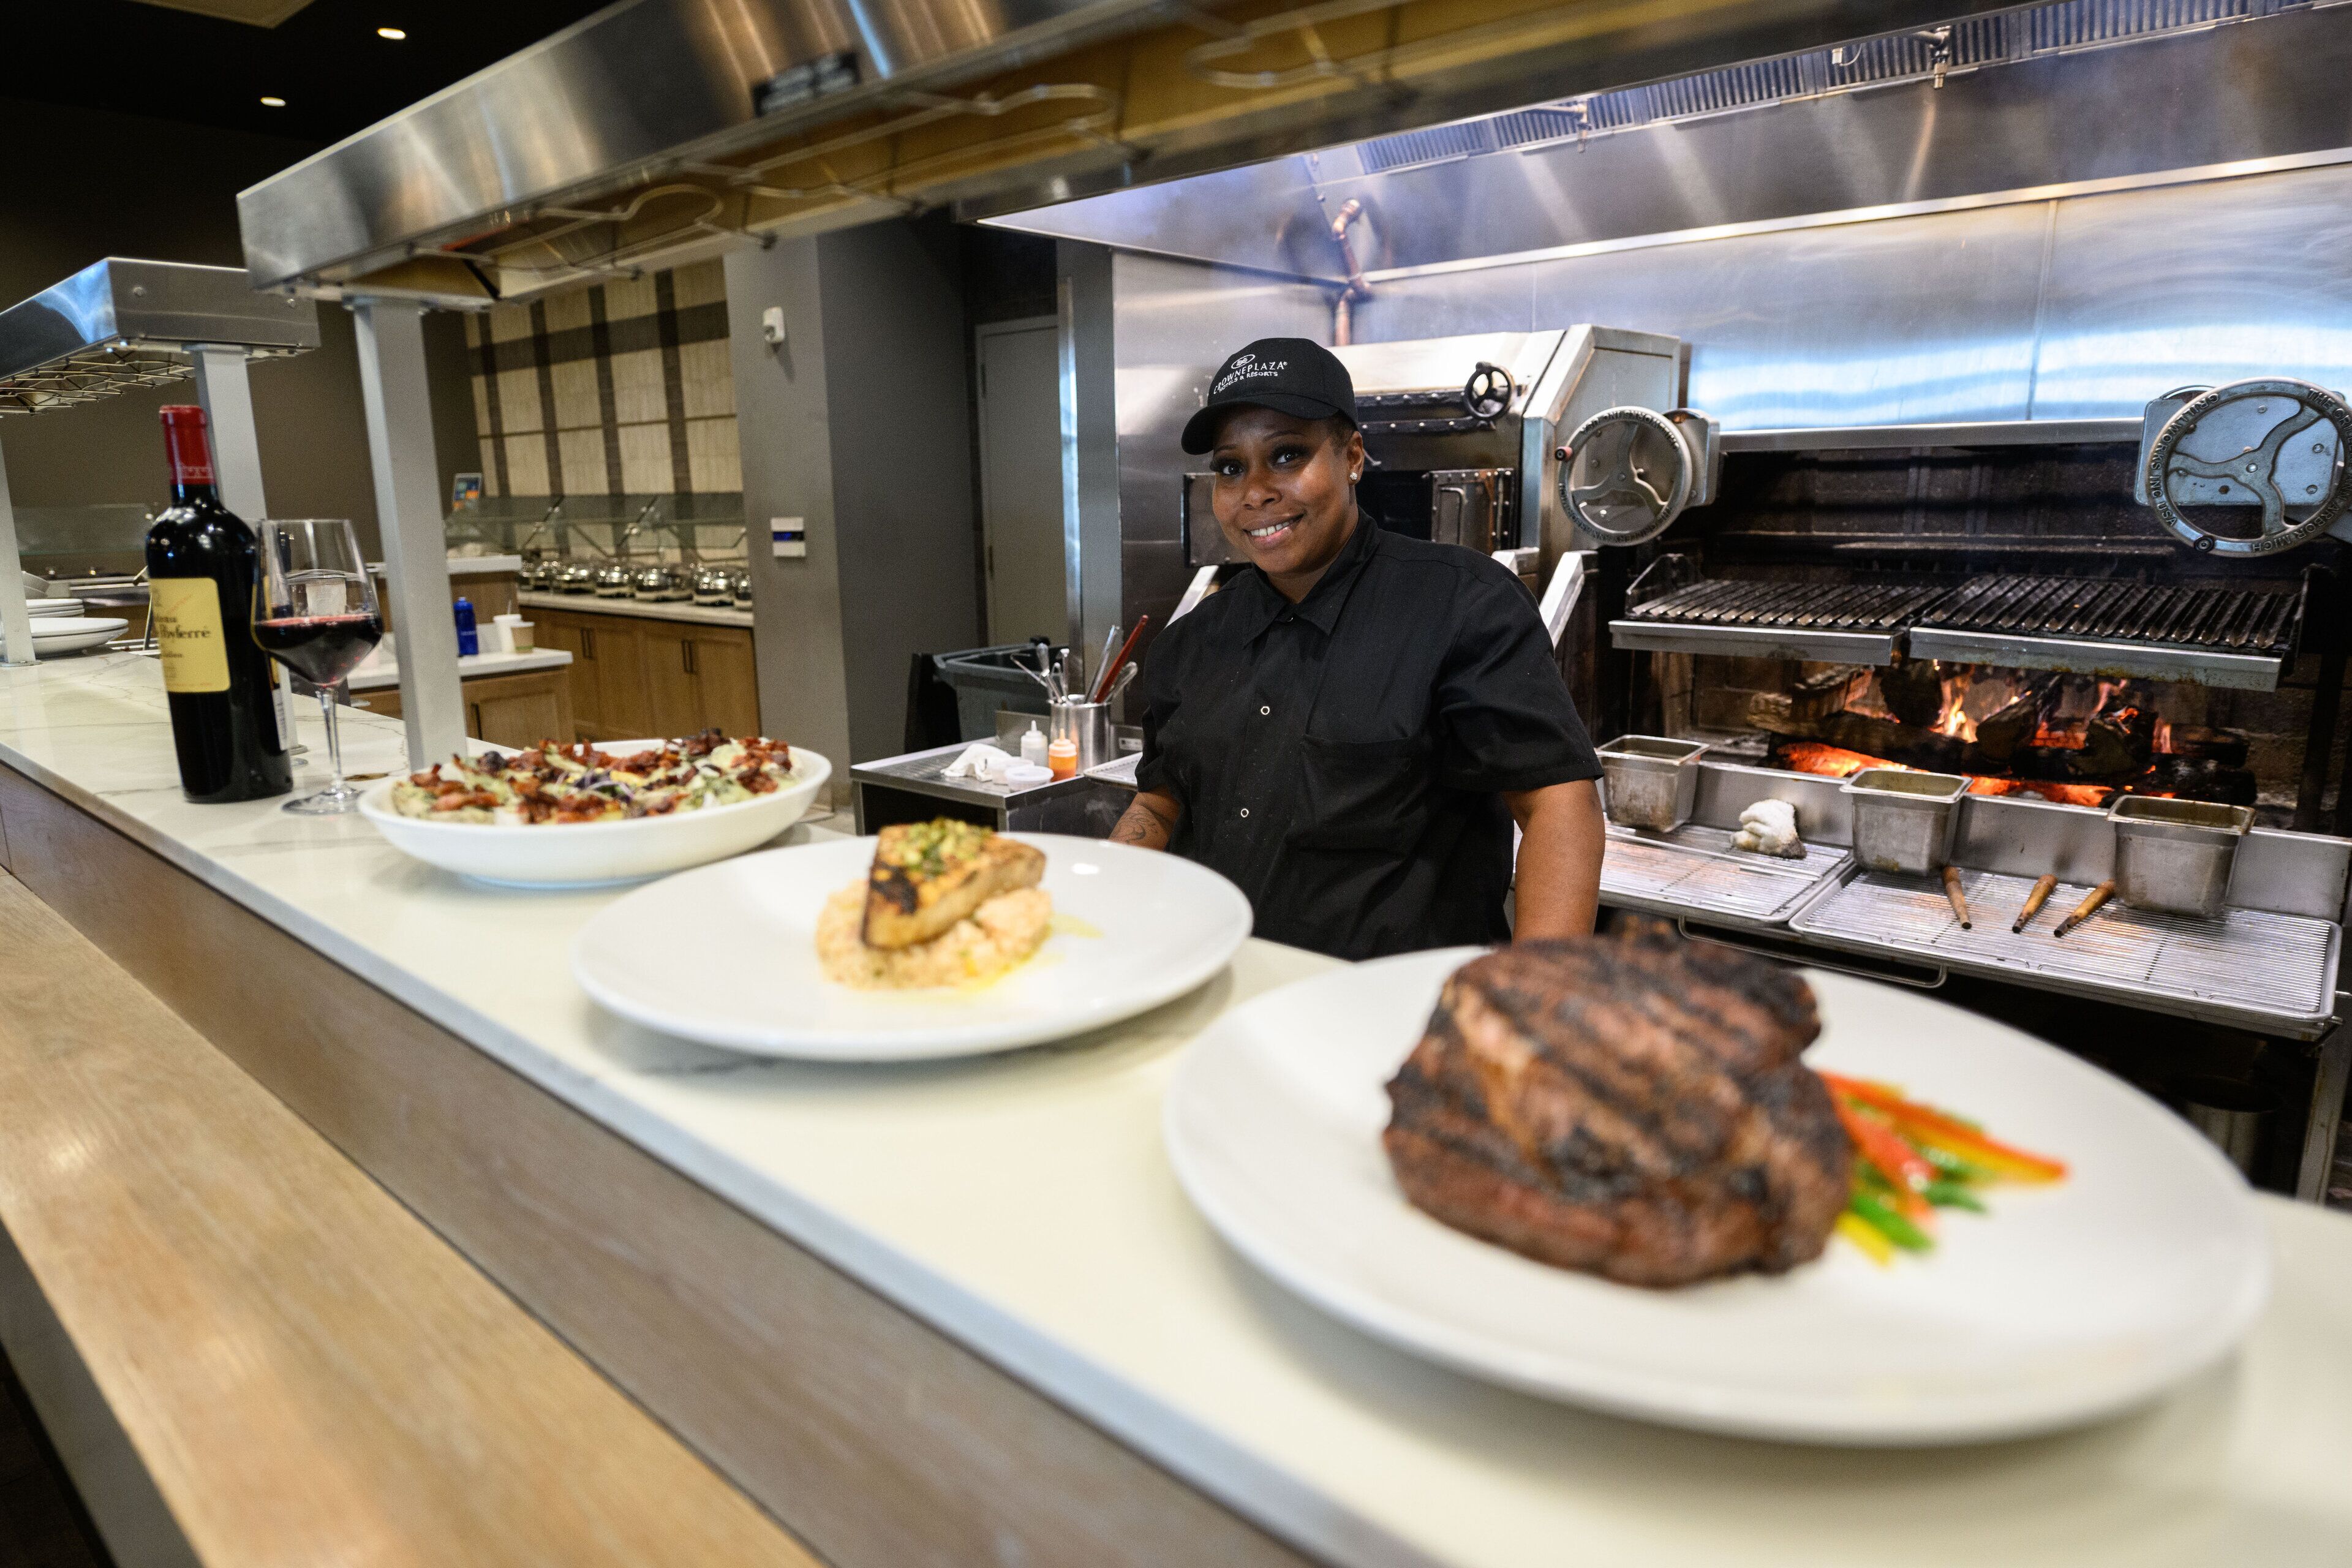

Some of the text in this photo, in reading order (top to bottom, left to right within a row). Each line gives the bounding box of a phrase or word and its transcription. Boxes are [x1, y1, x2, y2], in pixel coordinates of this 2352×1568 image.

[1219, 377, 1238, 393] HOTELS
[2309, 388, 2335, 409] THE
[2149, 393, 2218, 527] GRILLWORKS INC USA
[2293, 502, 2339, 540] ARBOR
[2252, 535, 2291, 552] MICH
